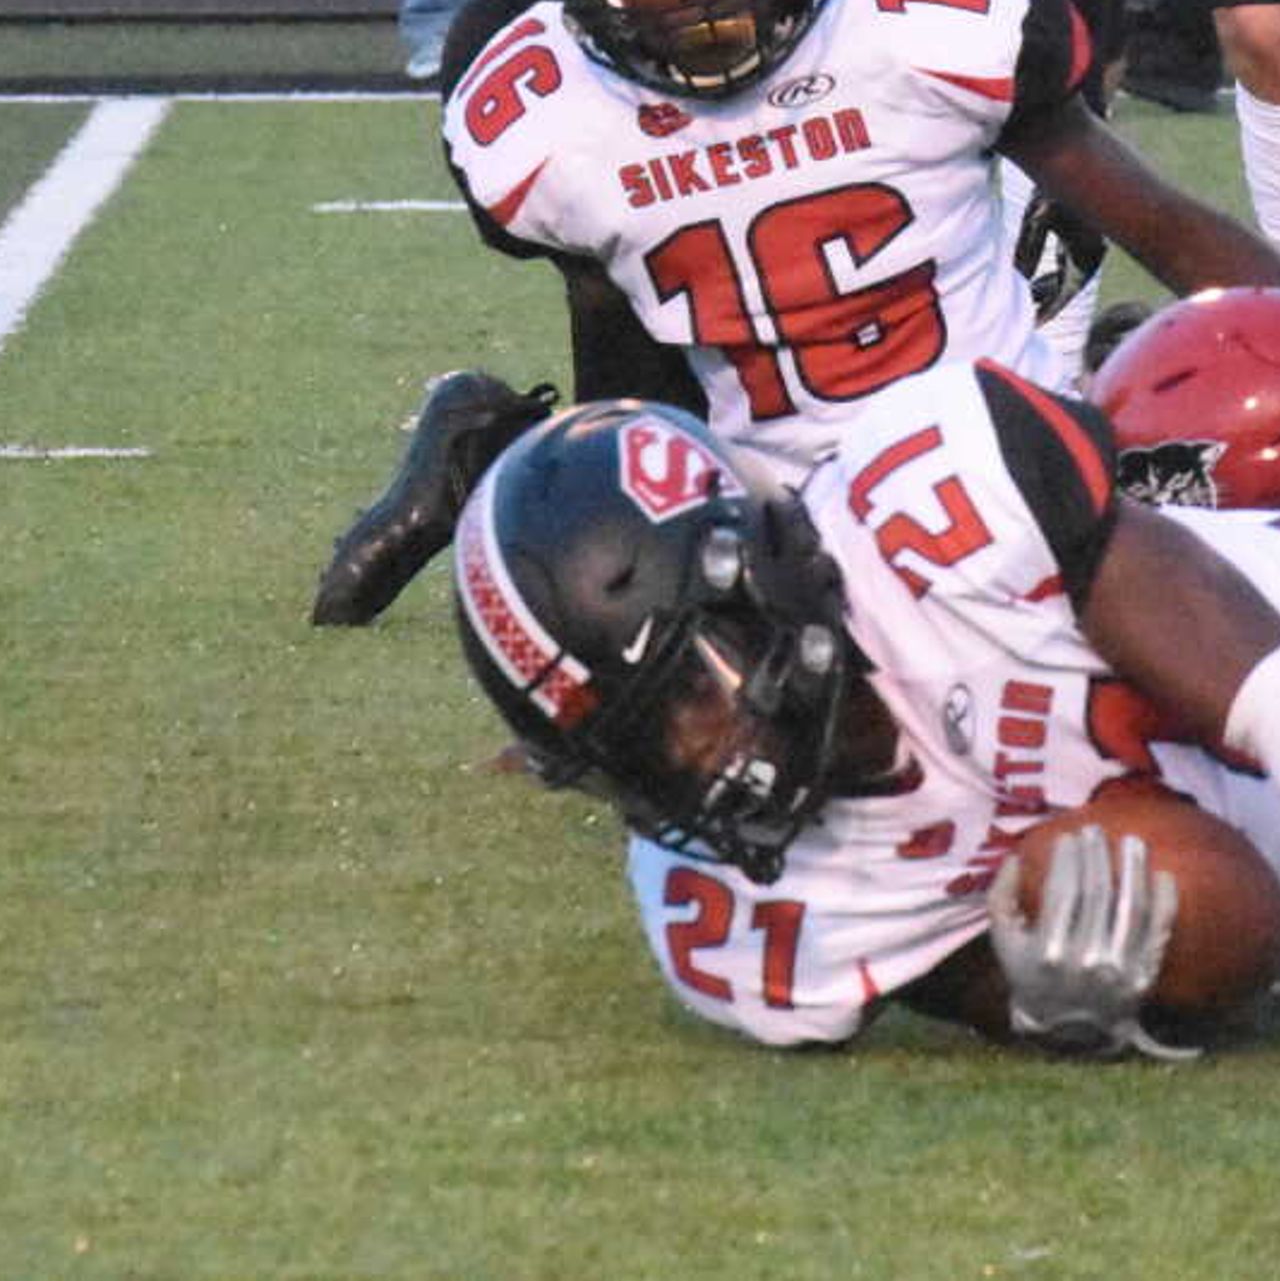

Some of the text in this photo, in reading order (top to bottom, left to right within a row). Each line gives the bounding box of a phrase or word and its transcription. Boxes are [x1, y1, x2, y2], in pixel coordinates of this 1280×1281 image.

[456, 18, 562, 148] 16
[619, 108, 872, 210] SIKESTON
[643, 180, 948, 422] 16
[664, 866, 807, 1010] 21
